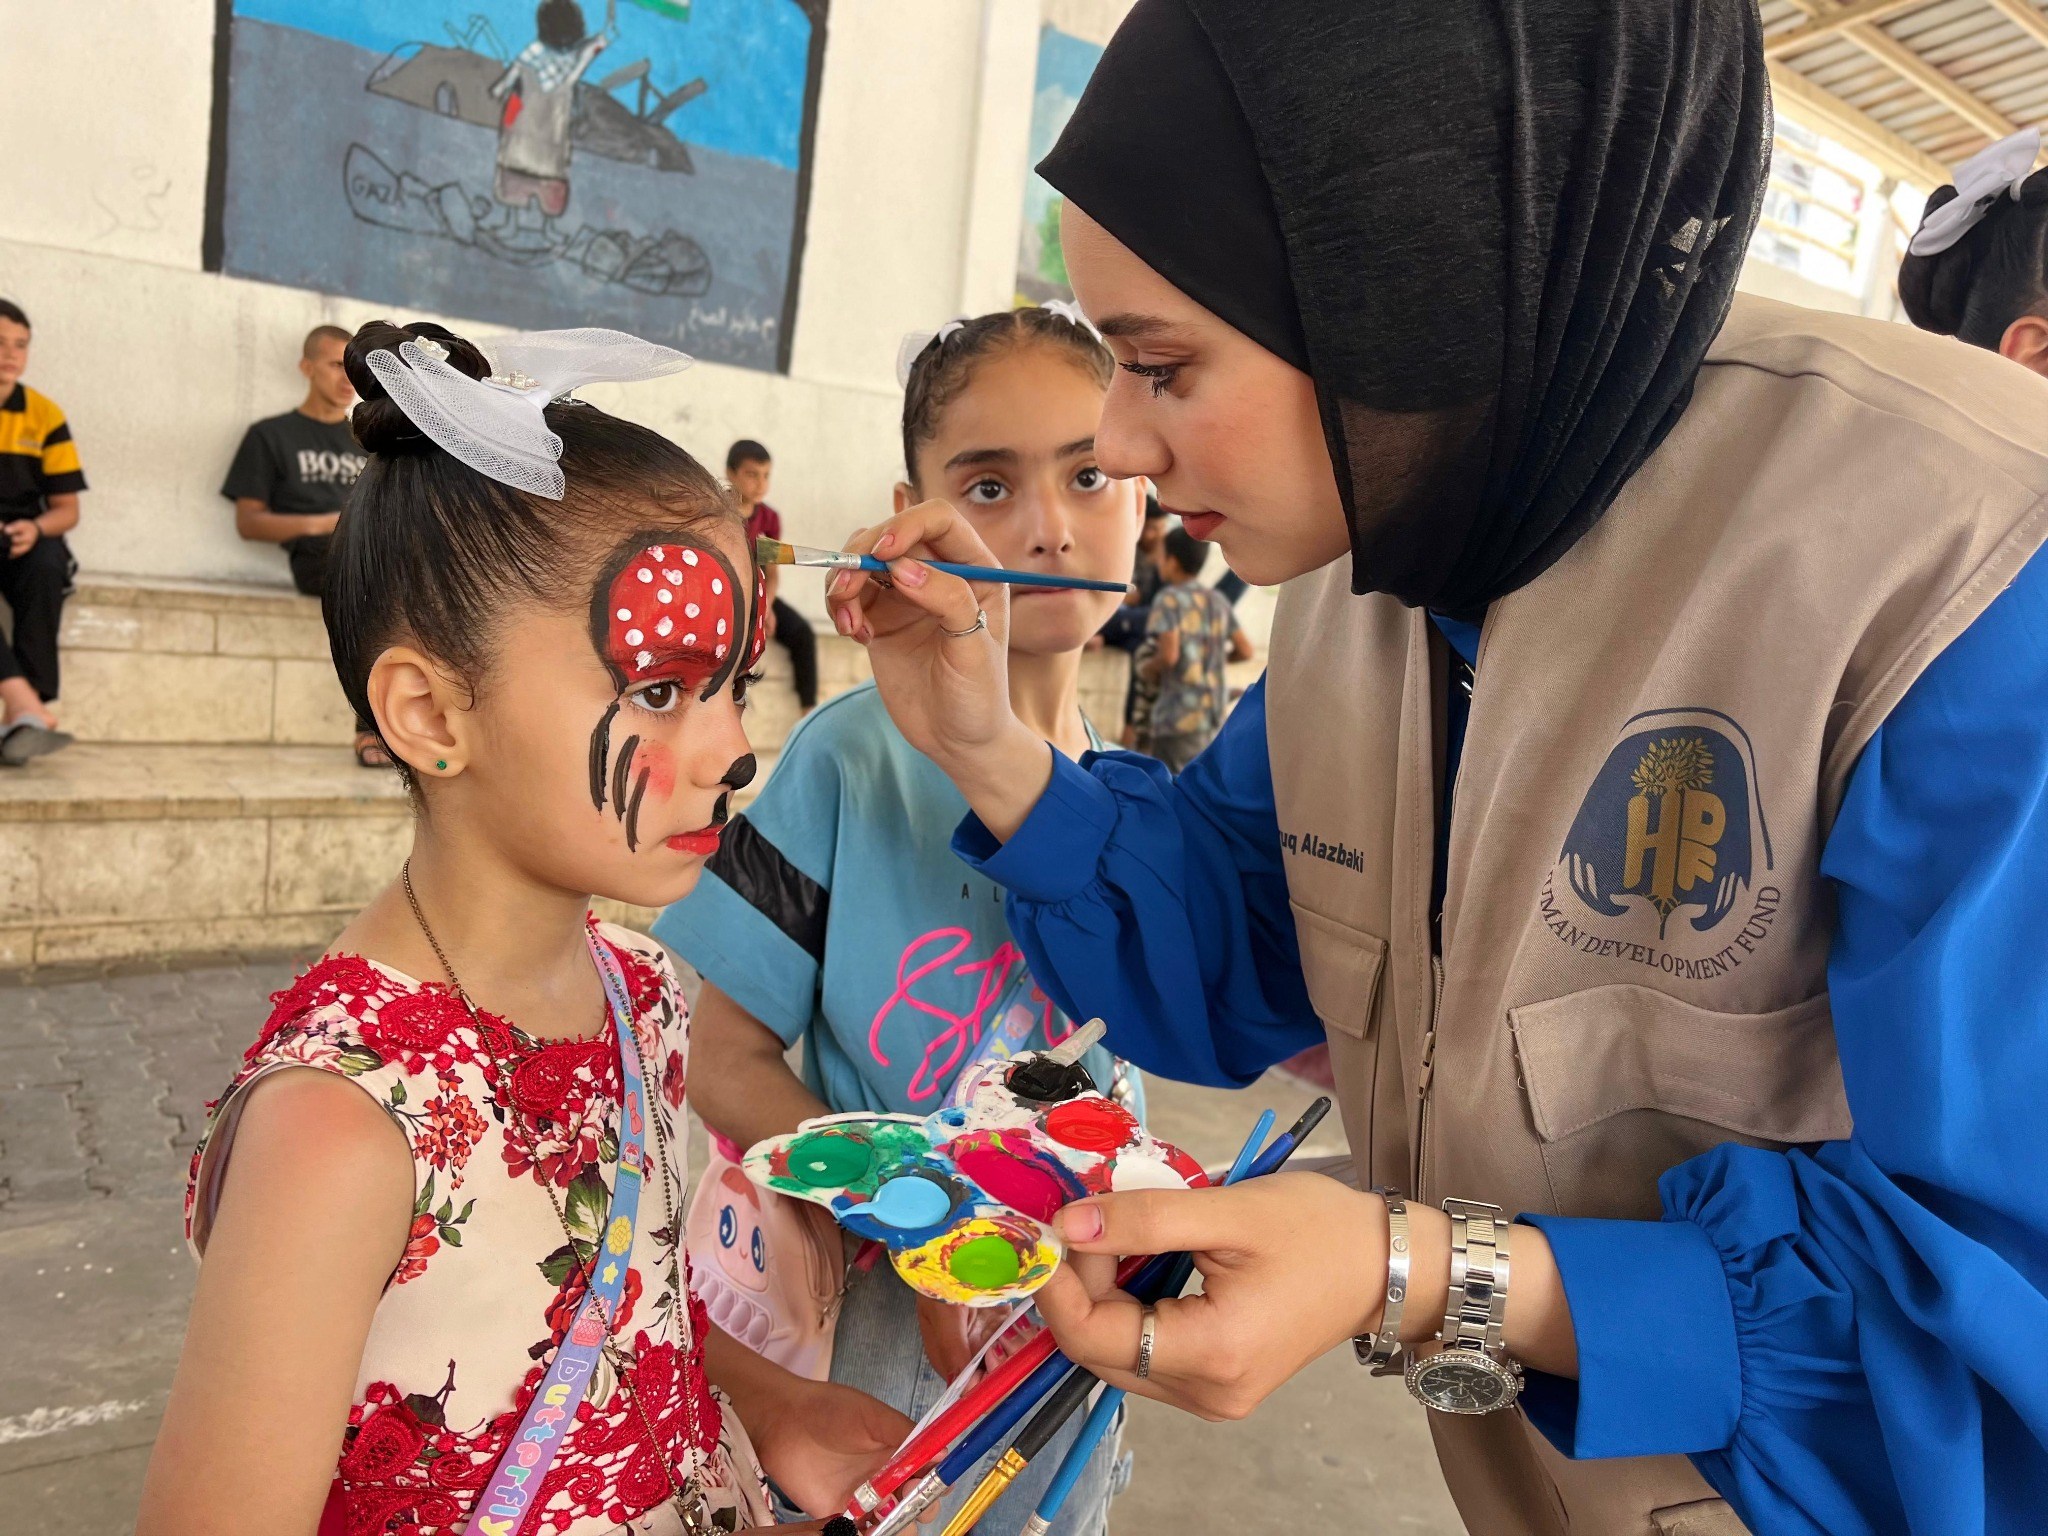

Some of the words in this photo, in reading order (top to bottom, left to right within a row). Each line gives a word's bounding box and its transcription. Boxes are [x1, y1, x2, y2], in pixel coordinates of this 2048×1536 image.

[1300, 832, 1364, 874] Alazbaki
[1581, 936, 1742, 980] DEVELOPMENT
[1734, 885, 1781, 954] FUND
